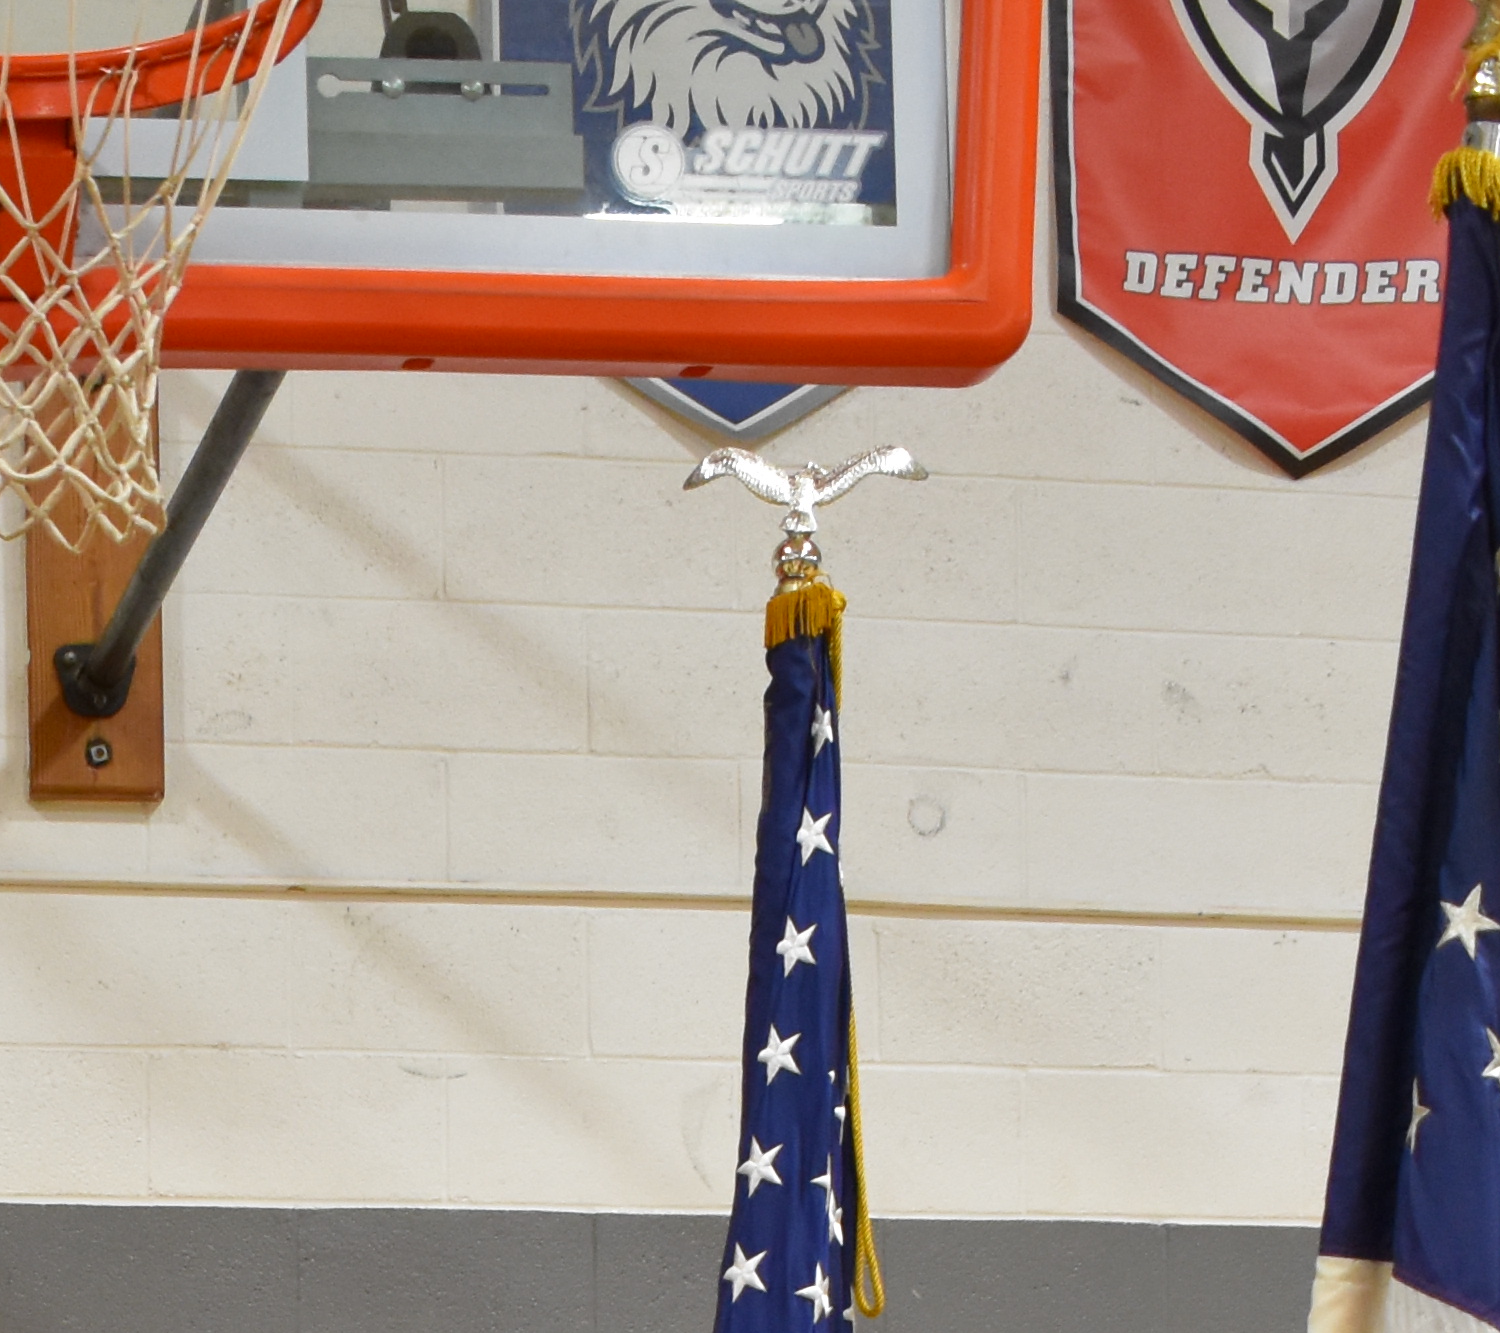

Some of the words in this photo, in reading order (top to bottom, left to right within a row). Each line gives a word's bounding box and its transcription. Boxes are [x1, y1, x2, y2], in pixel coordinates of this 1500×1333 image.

[693, 126, 887, 178] SCHUTT
[770, 179, 860, 203] SPORTS
[1122, 250, 1441, 305] DEFENDER
